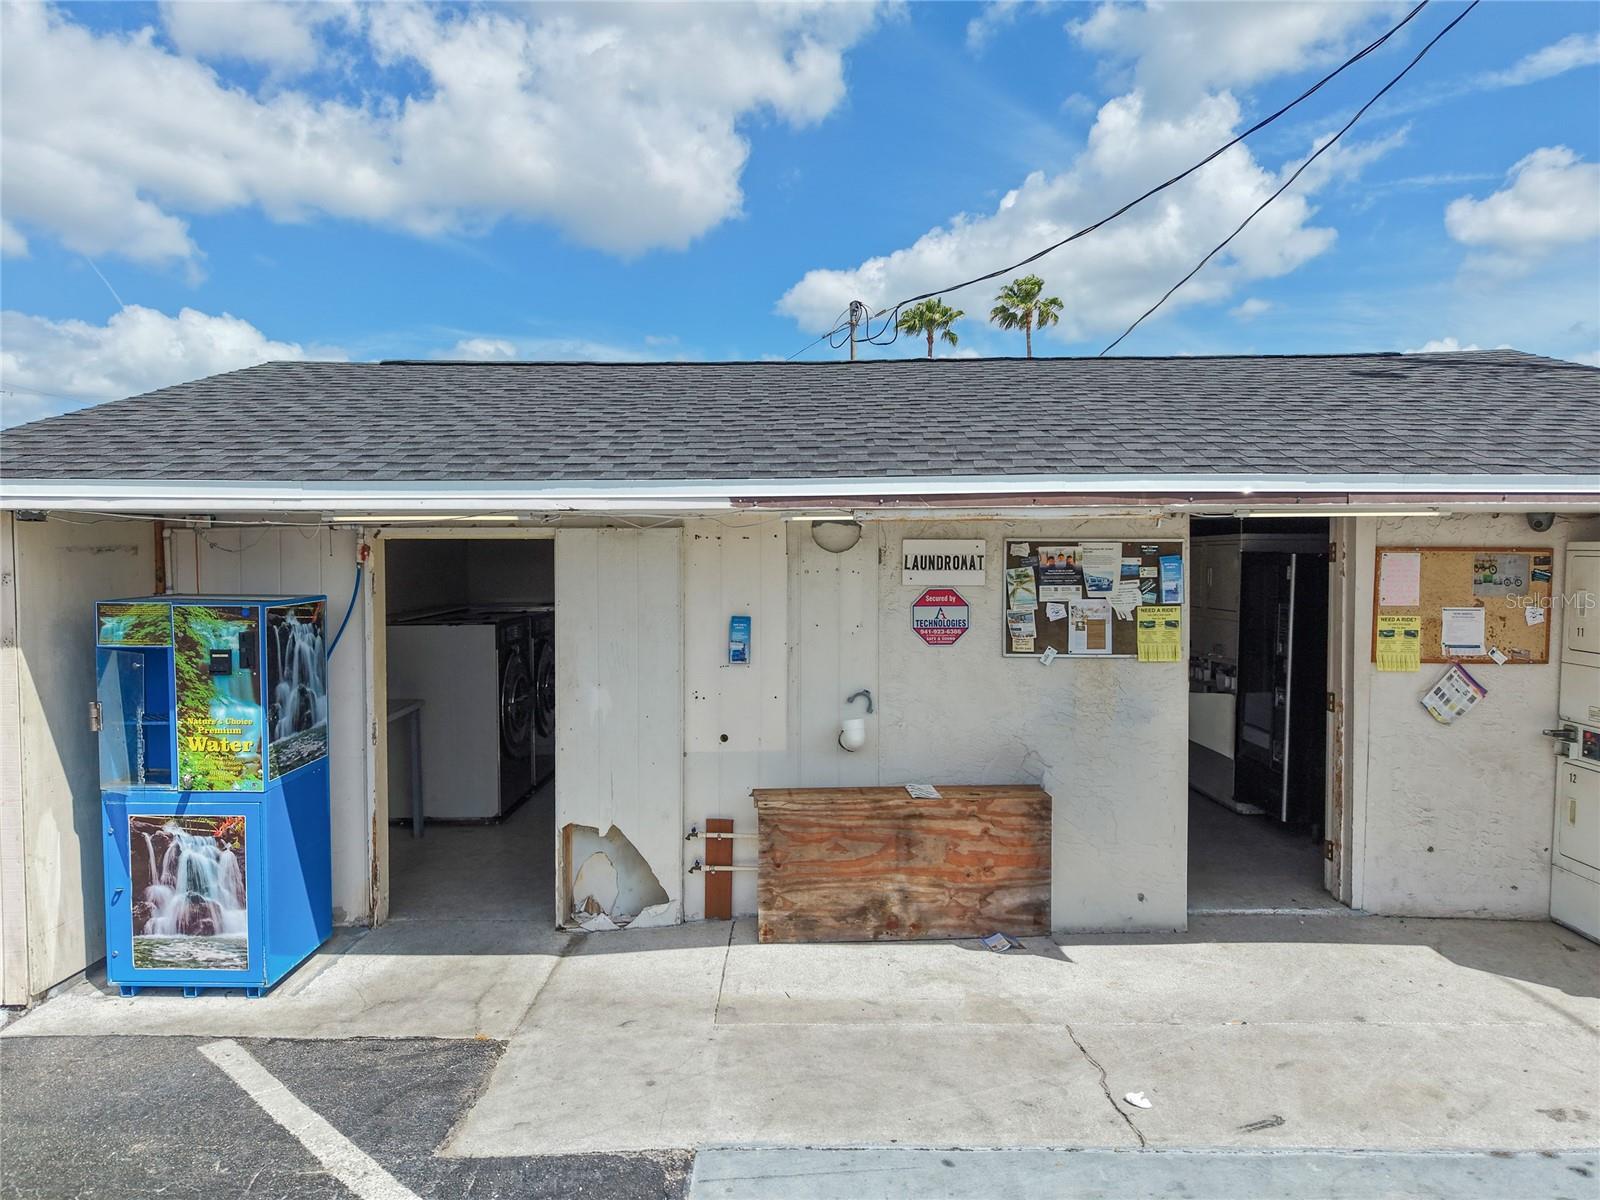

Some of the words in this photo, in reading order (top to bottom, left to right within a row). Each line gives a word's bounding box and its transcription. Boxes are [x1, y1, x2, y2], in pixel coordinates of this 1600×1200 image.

[904, 555, 984, 570] LAUNDROMAT
[948, 595, 956, 603] by
[915, 619, 967, 628] TECHNOLOGIES
[1577, 627, 1584, 637] 11
[197, 726, 243, 734] Premium
[187, 736, 254, 752] Water
[1569, 773, 1577, 784] 12
